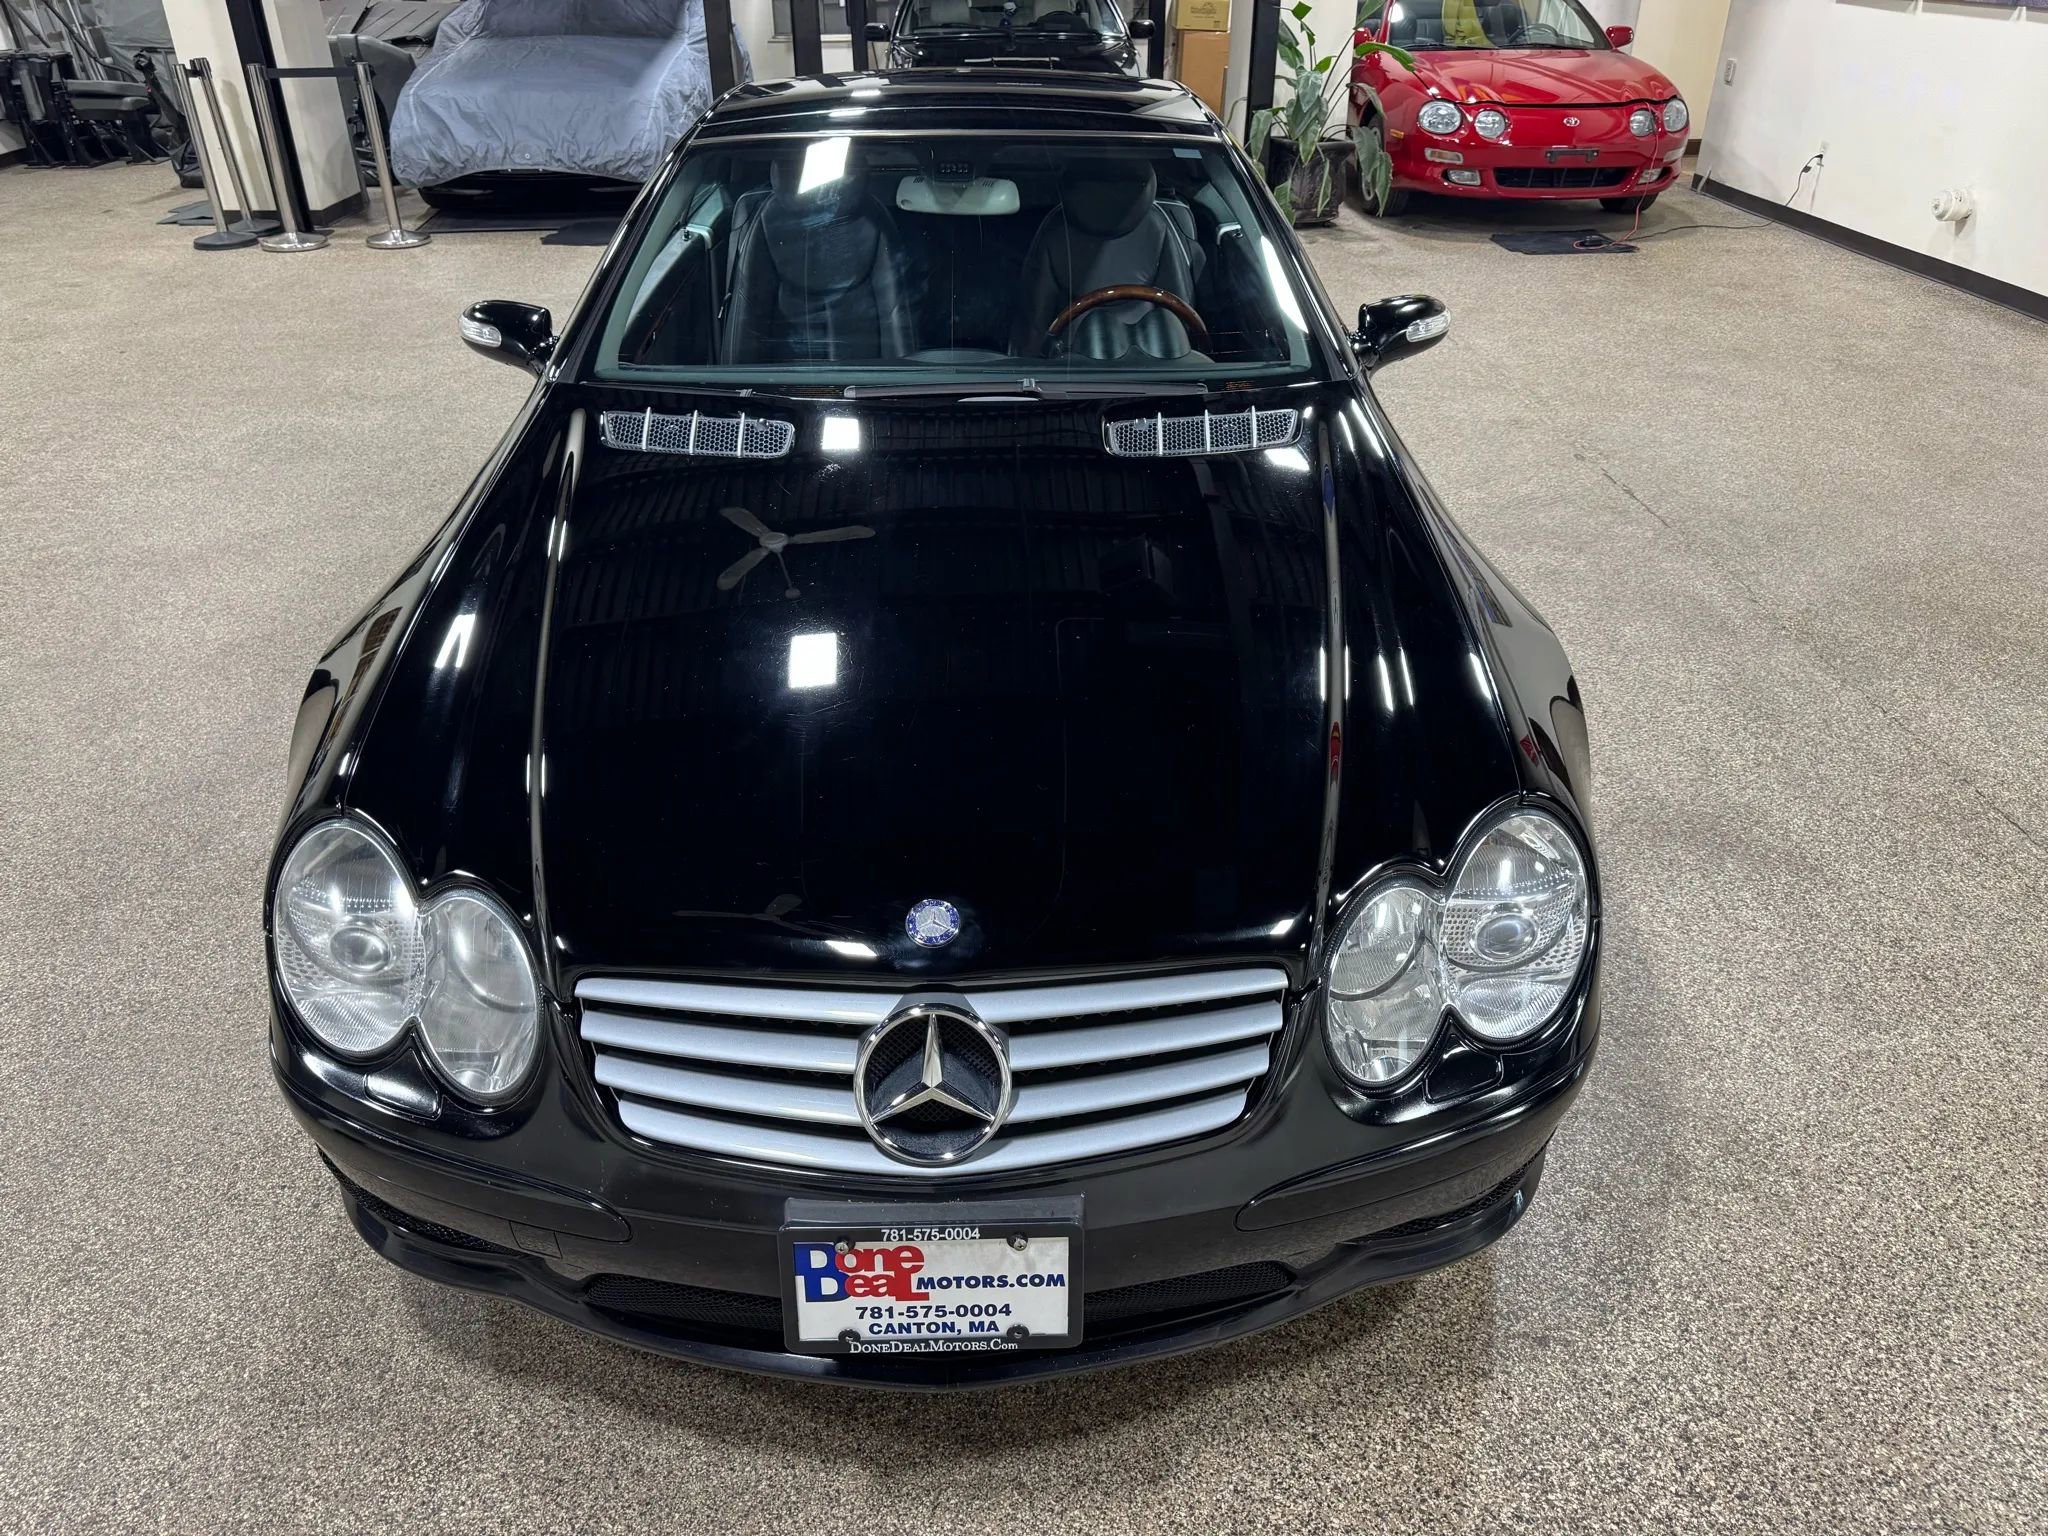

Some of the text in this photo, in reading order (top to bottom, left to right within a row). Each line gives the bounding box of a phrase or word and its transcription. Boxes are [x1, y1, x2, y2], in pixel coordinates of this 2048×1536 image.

[881, 1228, 981, 1241] 781-575-0004
[793, 1242, 925, 1276] Done
[915, 1273, 1066, 1291] MOTORS.COM
[855, 1303, 1012, 1320] 781-575-0004
[868, 1320, 1001, 1336] CANTON, MA
